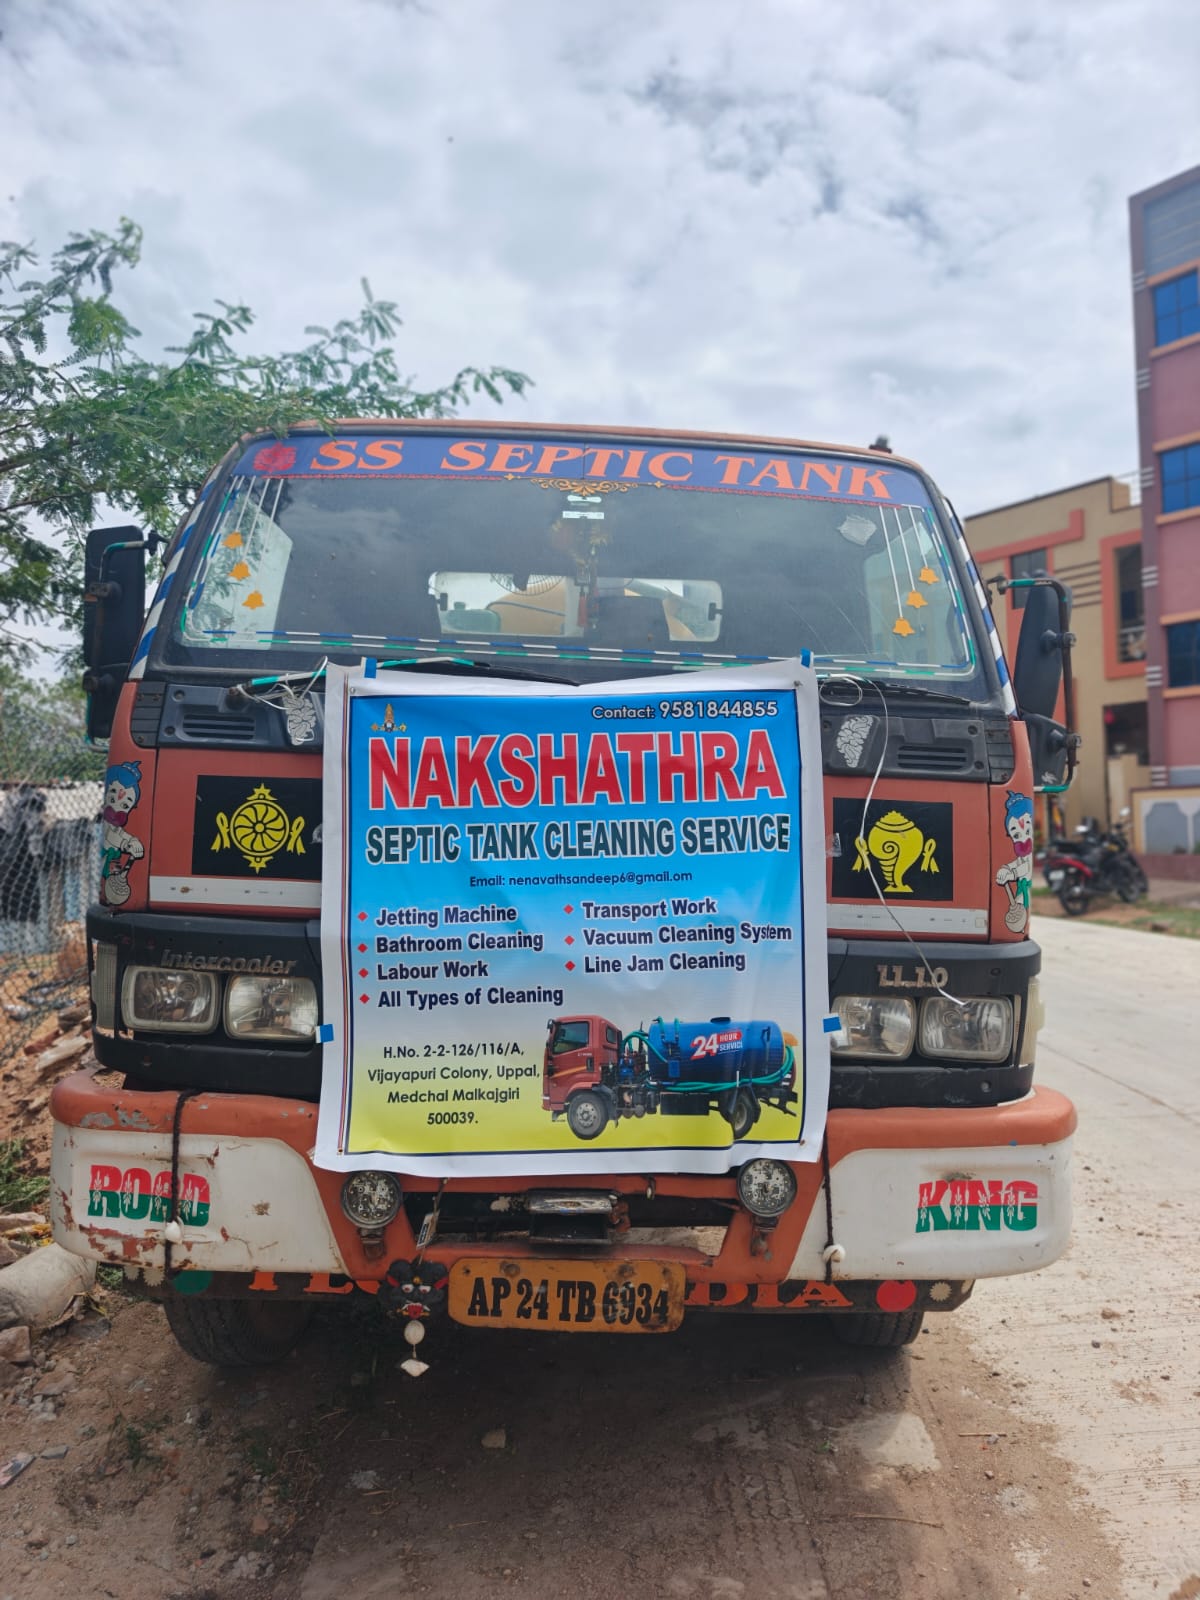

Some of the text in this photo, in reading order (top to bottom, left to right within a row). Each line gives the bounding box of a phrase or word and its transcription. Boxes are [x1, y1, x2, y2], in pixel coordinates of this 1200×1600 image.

[310, 439, 893, 499] SS SEPTIC TANK
[591, 700, 779, 720] Contact: 9581844855
[368, 729, 788, 811] NAKSHATHRA
[365, 814, 791, 865] SEPTIC TANK CLEANING SERVICE
[469, 876, 505, 887] Email:
[376, 905, 518, 928] Jetting Machine
[582, 897, 718, 919] Transport Work
[376, 931, 544, 955] Bathroom Cleaning
[583, 922, 793, 947] Vacuum Cleaning System
[161, 949, 297, 974] Intercooler
[377, 961, 489, 981] Labour Work
[584, 952, 747, 974] Line Jam Cleaning
[378, 985, 564, 1008] All Types of Cleaning
[383, 1042, 525, 1059] H.No. 2-2-126/116/A,
[690, 1033, 718, 1058] 24
[367, 1064, 540, 1084] Vijayapuri Colony, Uppal,
[387, 1087, 520, 1104] Medchal Malkajgiri
[427, 1111, 479, 1125] 500039.
[87, 1164, 211, 1227] ROAD
[916, 1180, 1038, 1233] KING
[467, 1277, 669, 1325] AP 24 TB 6934
